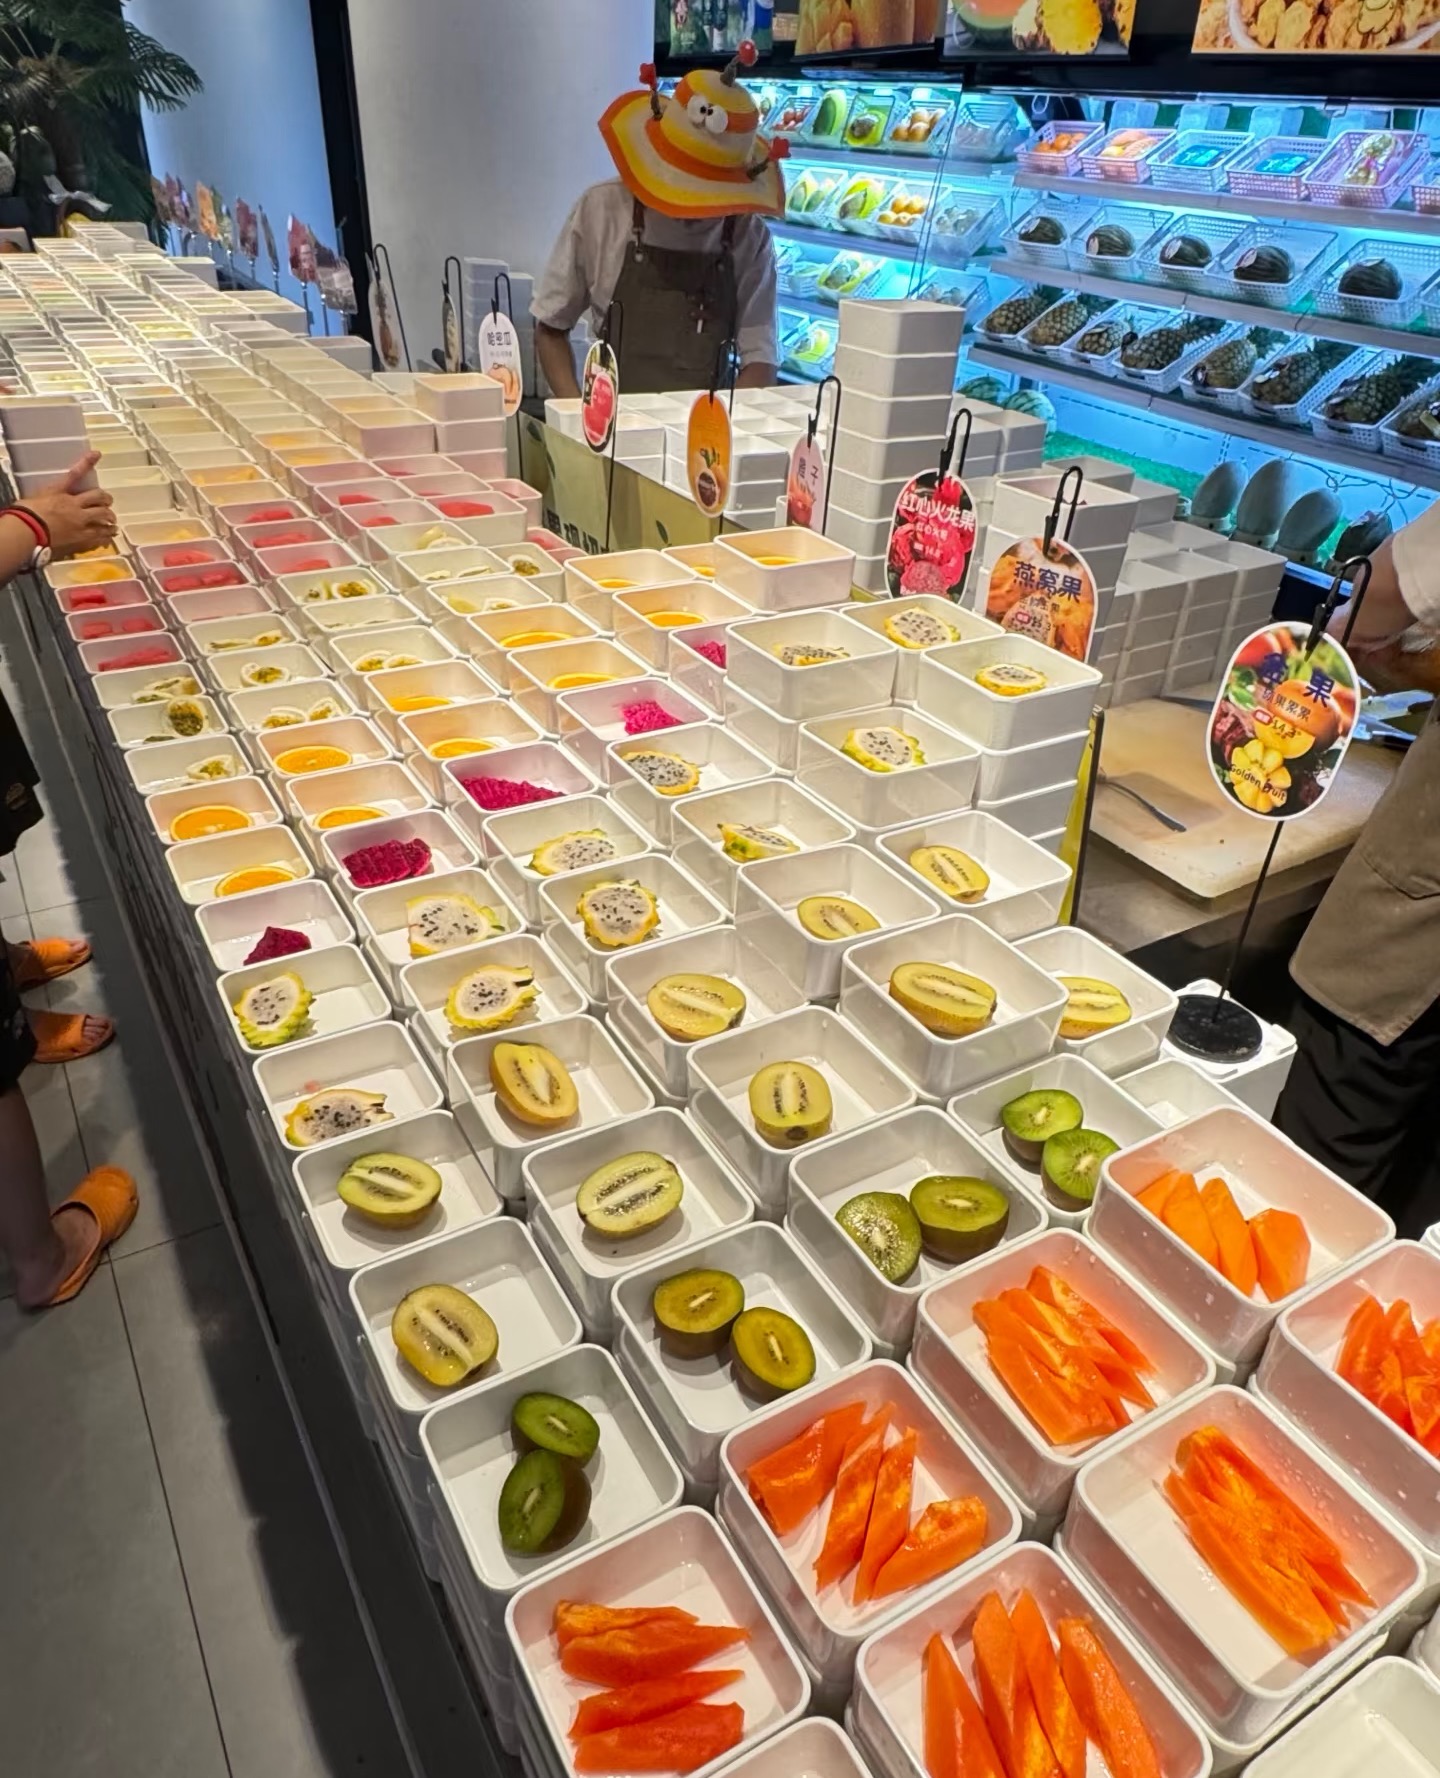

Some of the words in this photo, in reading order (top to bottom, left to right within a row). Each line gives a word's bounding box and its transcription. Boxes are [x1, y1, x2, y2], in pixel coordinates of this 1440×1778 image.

[900, 490, 975, 532] 红心火龙果
[1013, 561, 1082, 603] 燕窝果
[1230, 763, 1262, 789] Golden
